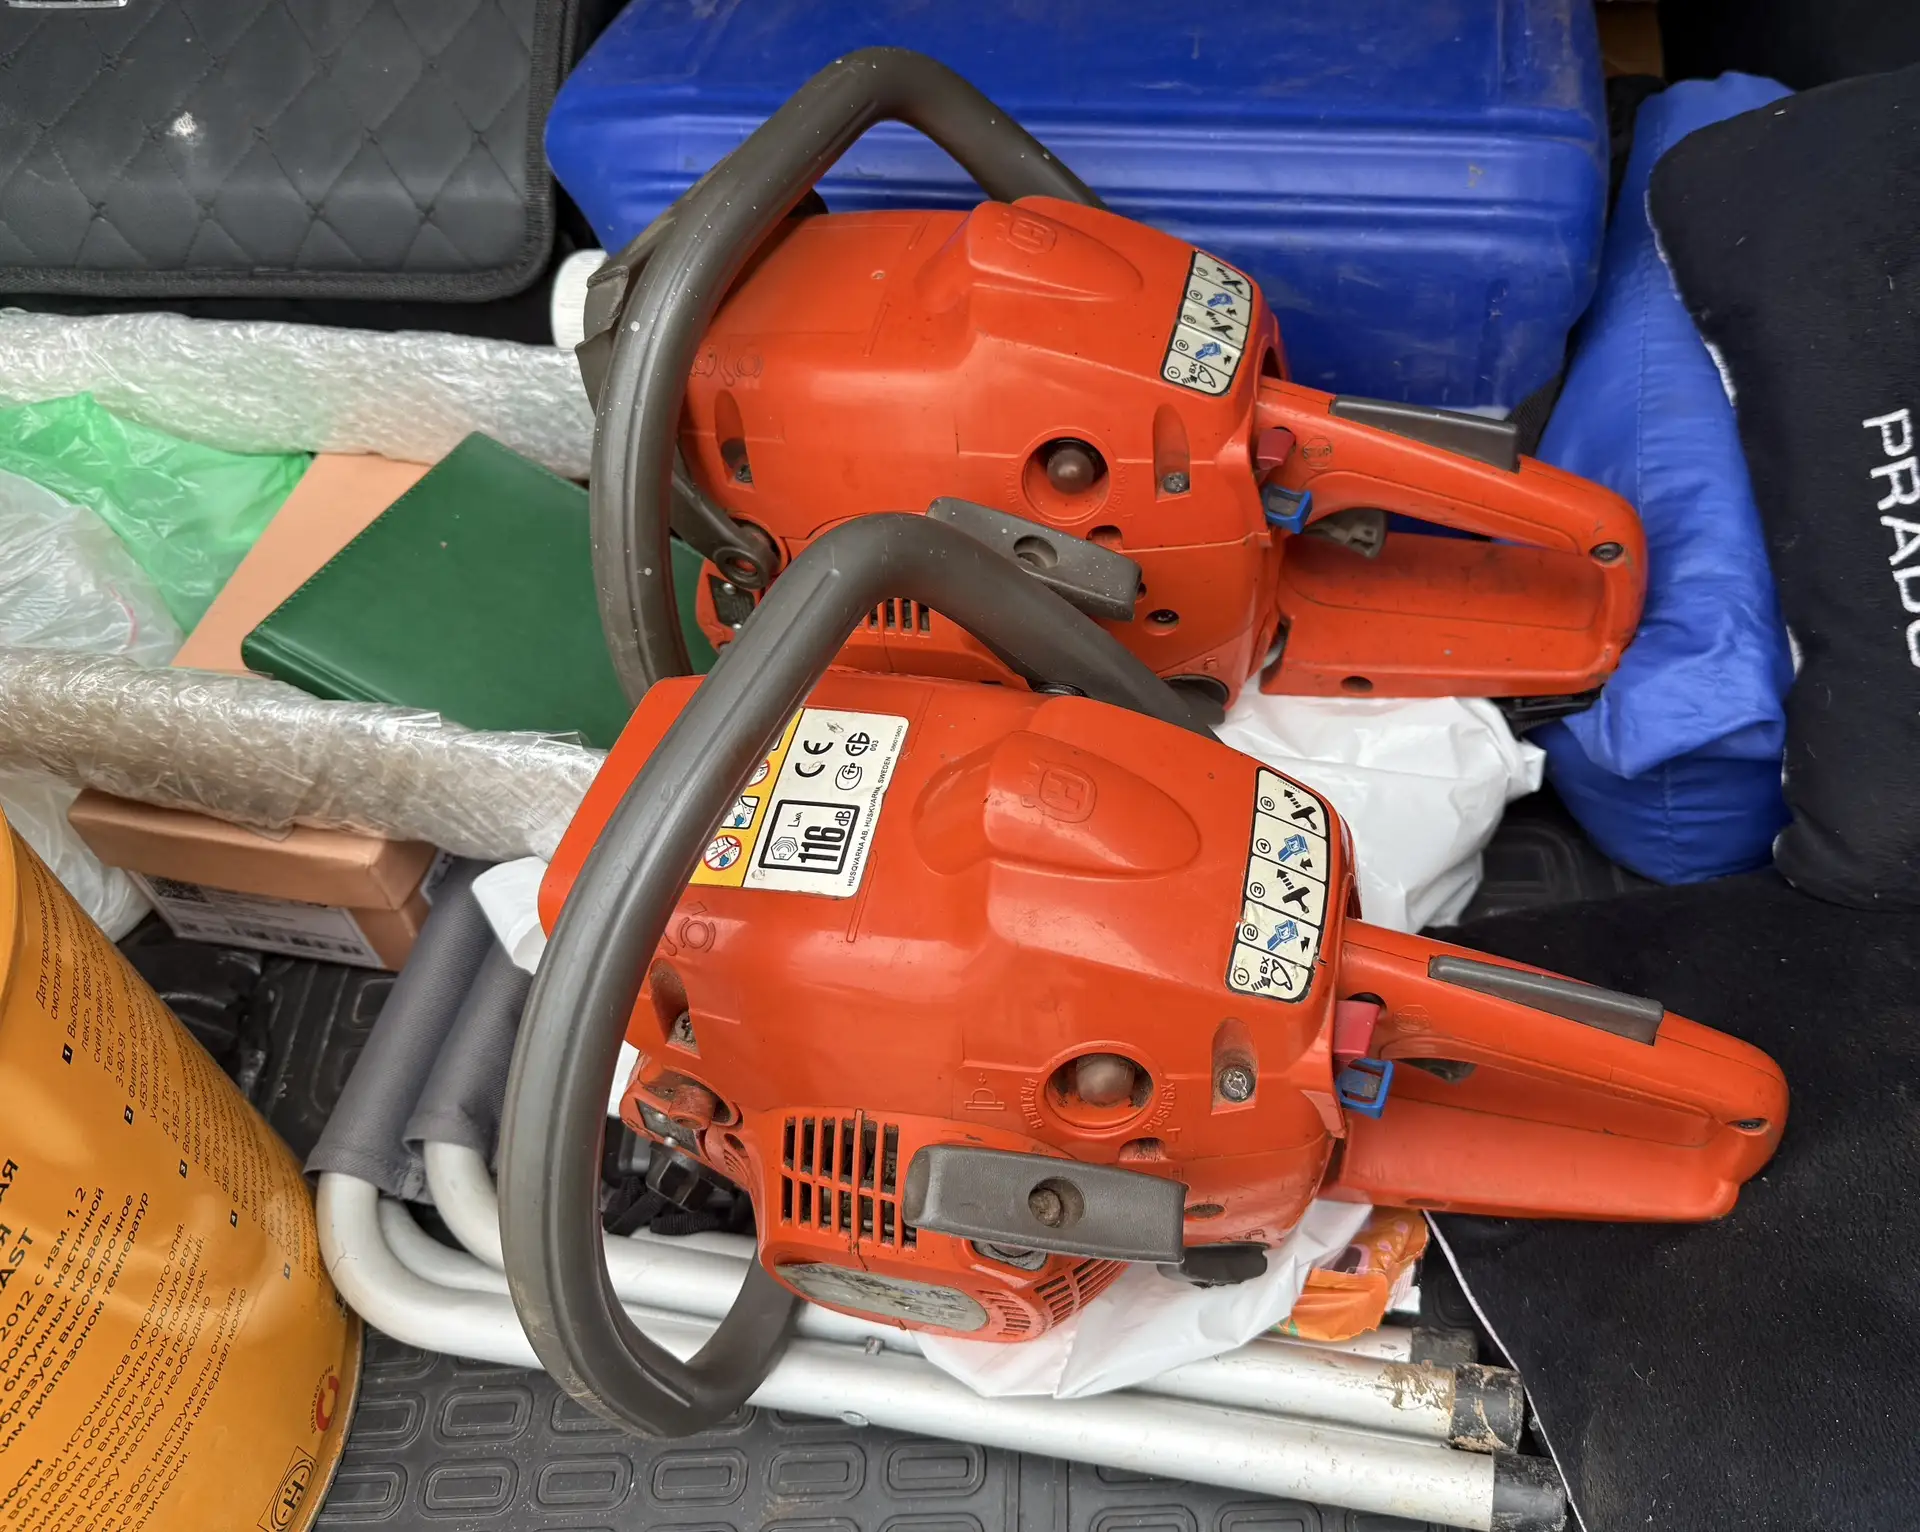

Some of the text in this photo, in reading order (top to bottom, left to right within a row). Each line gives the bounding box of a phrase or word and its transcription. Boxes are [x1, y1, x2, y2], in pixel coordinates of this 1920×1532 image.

[869, 740, 880, 752] 003
[878, 756, 892, 784] SWEDEN
[834, 807, 852, 826] dB
[860, 828, 870, 841] AB,
[864, 784, 883, 827] HUSKVARNA,
[798, 826, 846, 862] 116
[846, 842, 866, 886] HUSQVARNA
[36, 968, 49, 1010] Дату
[50, 952, 64, 1020] смотрите
[66, 948, 80, 1040] Выборгский
[94, 1026, 102, 1064] ский
[128, 1042, 138, 1098] Филиал
[1020, 1077, 1045, 1130] PRIMER
[214, 1166, 222, 1187] ул.
[44, 1228, 70, 1270] изм.
[74, 1186, 86, 1204] 2
[52, 1186, 104, 1288] мастичной
[4, 1210, 112, 1392] битумных кровель.
[26, 1300, 104, 1420] диапазоном
[102, 1192, 148, 1296] температур
[58, 1194, 134, 1344] высокопрочное
[6, 1224, 186, 1520] вблизи источников открытого огня.
[96, 1394, 138, 1452] внутри
[136, 1334, 172, 1392] жилых
[168, 1238, 204, 1332] помещений.
[40, 1452, 82, 1504] работ
[82, 1350, 148, 1450] обеспечить
[146, 1270, 182, 1348] хорошую
[78, 1370, 166, 1500] рекомендуется
[164, 1356, 174, 1368] в
[172, 1270, 208, 1354] перчатках.
[86, 1466, 120, 1512] кожу
[122, 1396, 164, 1460] мастику
[164, 1296, 210, 1396] необходимо
[116, 1464, 152, 1516] работ
[152, 1358, 212, 1462] инструменты
[210, 1288, 236, 1354] очистить
[132, 1416, 194, 1512] застывший
[192, 1342, 230, 1418] материал
[228, 1288, 246, 1340] можно
